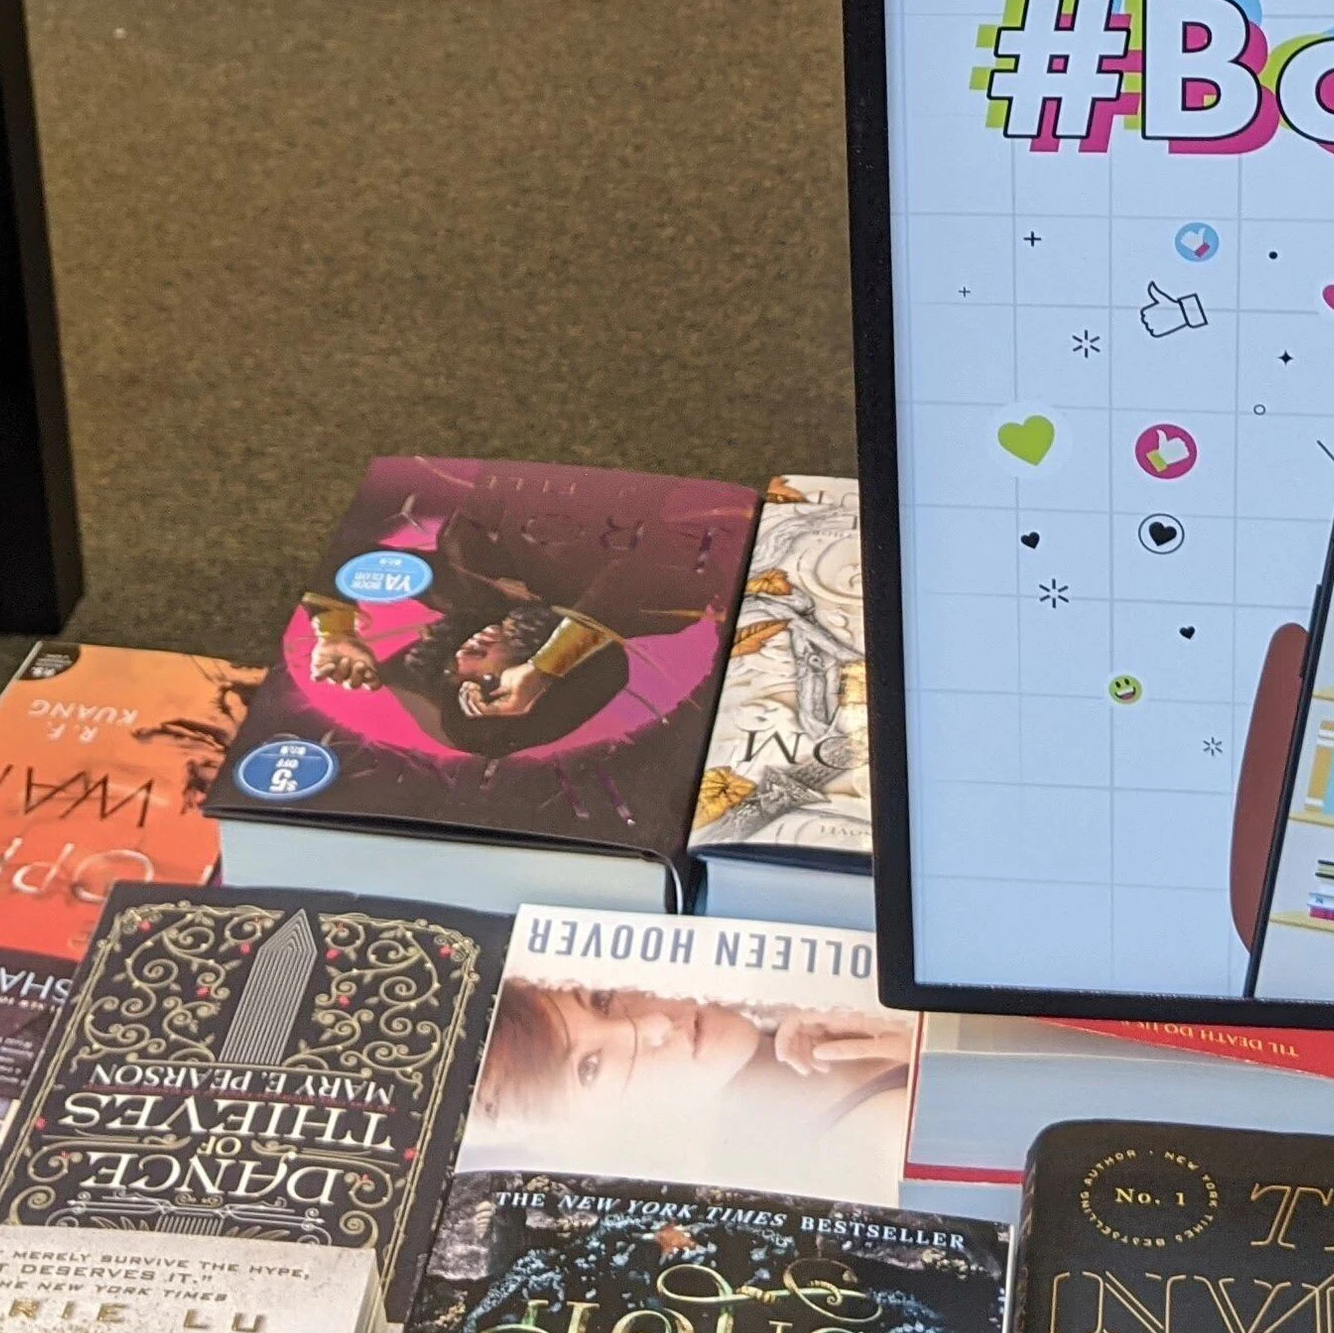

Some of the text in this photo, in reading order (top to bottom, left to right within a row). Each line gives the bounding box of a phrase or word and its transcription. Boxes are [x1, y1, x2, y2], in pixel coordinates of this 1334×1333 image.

[27, 698, 140, 726] KUANG
[268, 768, 299, 794] $5
[527, 917, 873, 980] OLLEEN HOOVER
[1163, 1022, 1195, 1039] DO
[1199, 1029, 1263, 1052] DEATH
[1267, 1040, 1300, 1058] TIL
[88, 1063, 395, 1106] MARY E. PEARSON
[57, 1091, 396, 1152] THIEVES
[197, 1135, 242, 1157] OF
[1083, 1148, 1138, 1187] AUTHOR
[1164, 1150, 1201, 1171] NEW
[77, 1150, 345, 1206] DANCE
[1115, 1187, 1188, 1207] No. 1
[494, 1189, 967, 1252] THE NEW YORK TIMES BESTSELLER
[14, 1249, 92, 1264] MERELY
[99, 1253, 193, 1270] SURVIVE
[199, 1259, 242, 1274] THE
[247, 1264, 311, 1283] HYPE,
[19, 1262, 157, 1282] DESERVES
[37, 1280, 83, 1295] NEW
[93, 1284, 152, 1299] YORK
[162, 1287, 230, 1304] TIMES
[181, 1308, 270, 1333] LU
